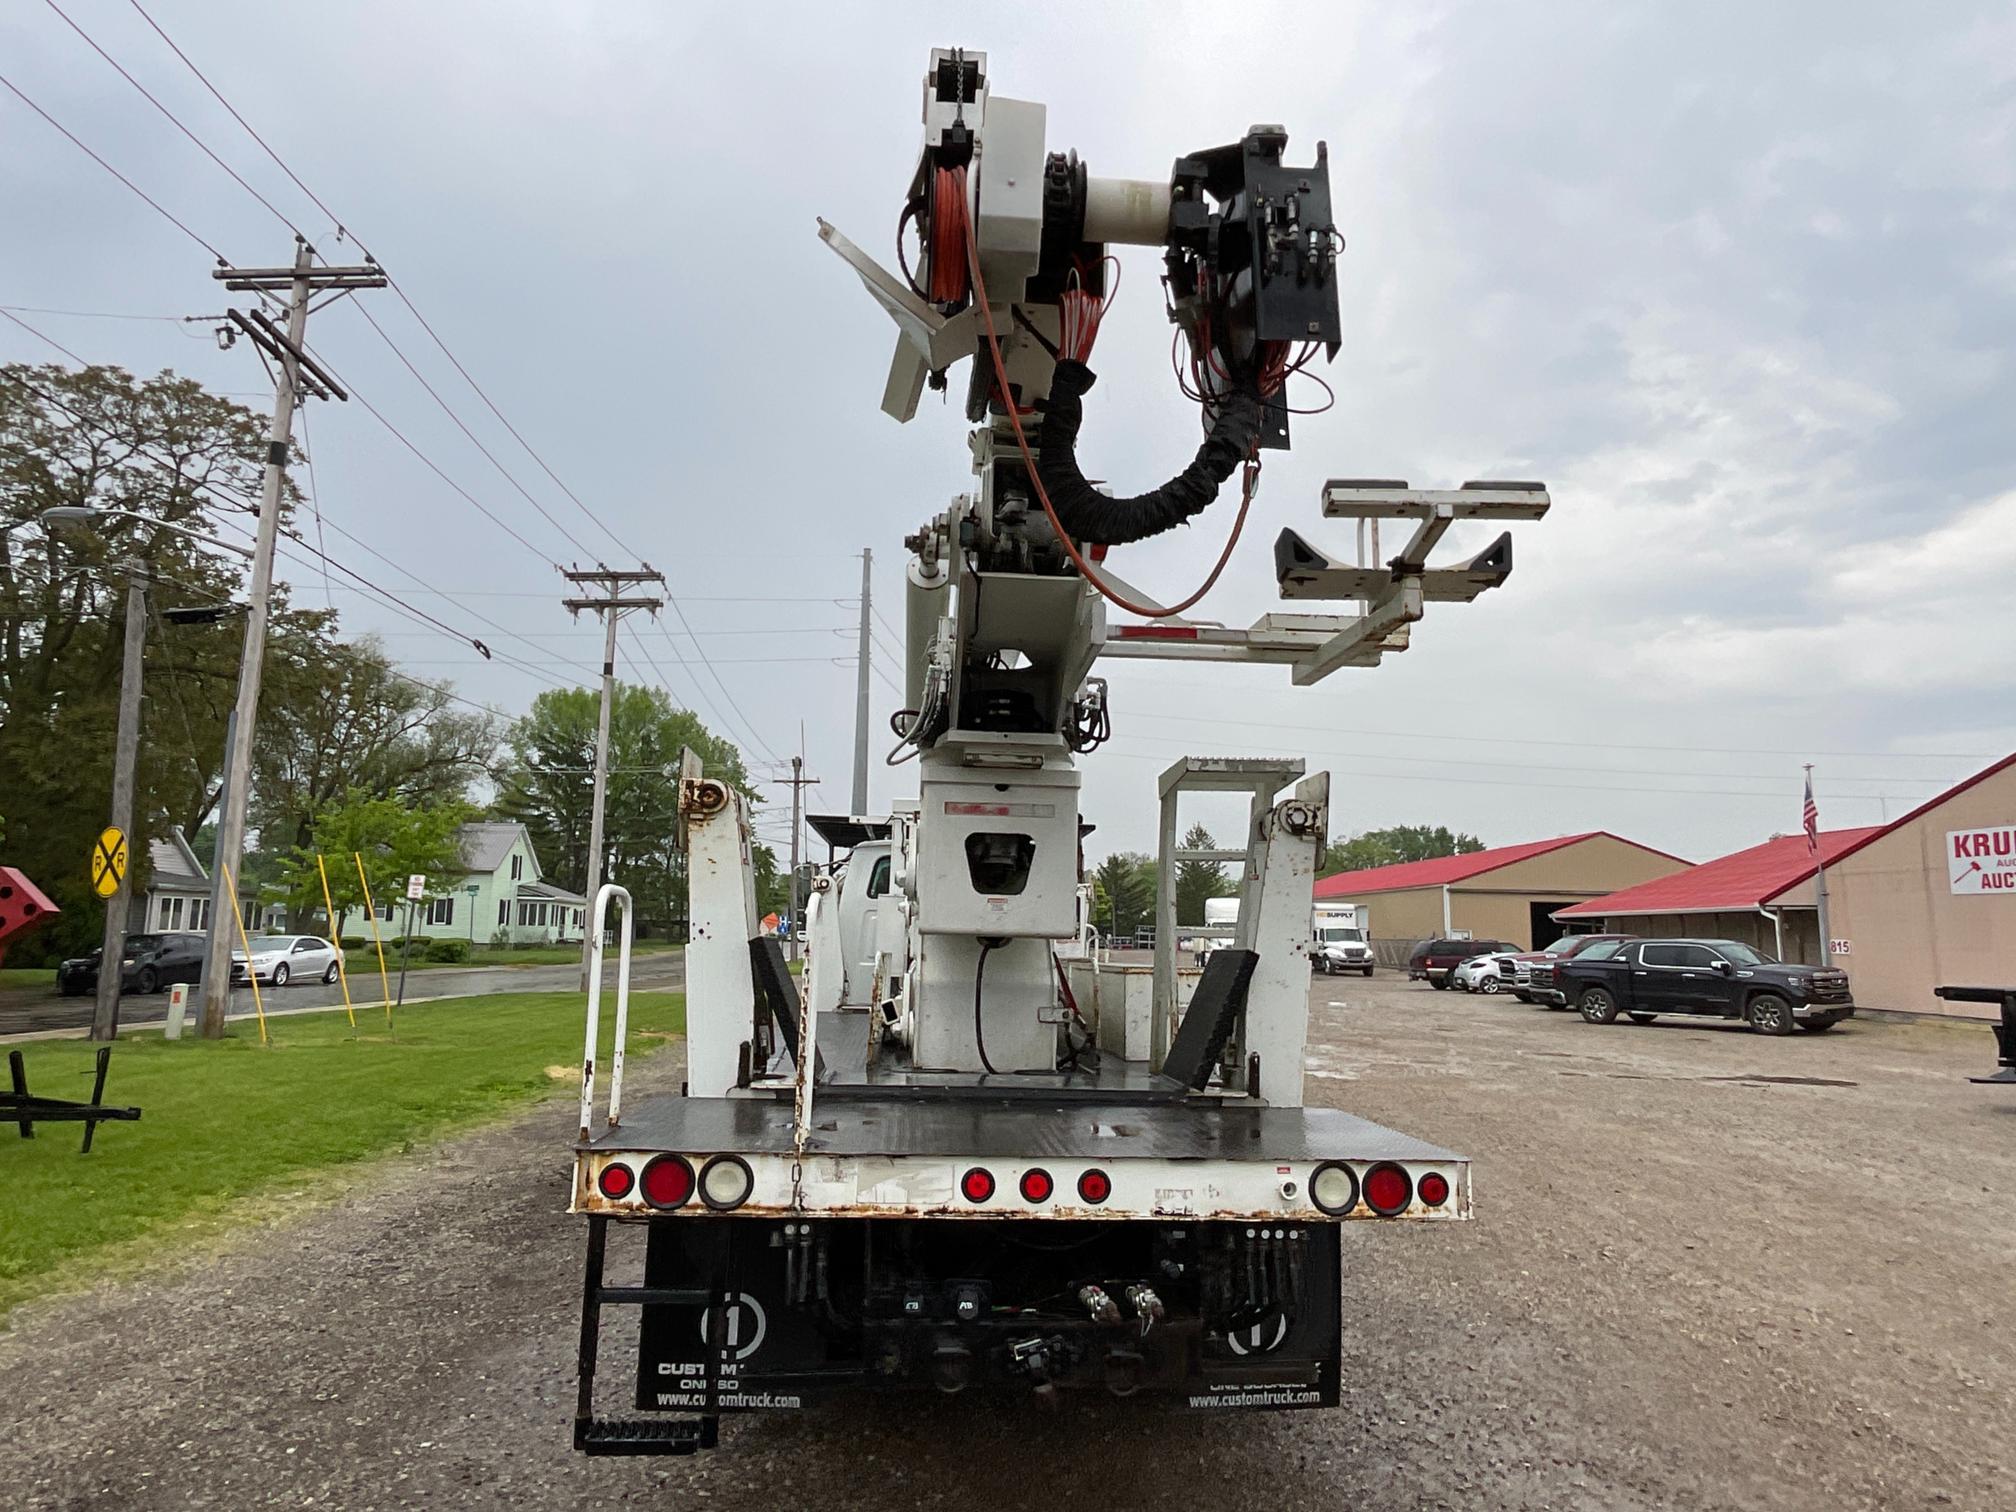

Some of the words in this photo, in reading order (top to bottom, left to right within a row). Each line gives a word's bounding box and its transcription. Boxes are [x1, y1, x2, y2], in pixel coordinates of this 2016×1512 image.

[1954, 830, 2016, 858] KRU
[95, 855, 102, 872] R
[117, 852, 125, 869] R
[1981, 872, 2016, 889] AUC
[1830, 941, 1850, 953] 815
[658, 1363, 737, 1375] CUSTM
[657, 1392, 801, 1408] www.cuomtruck.com
[1189, 1389, 1320, 1408] www.customtruck.com
